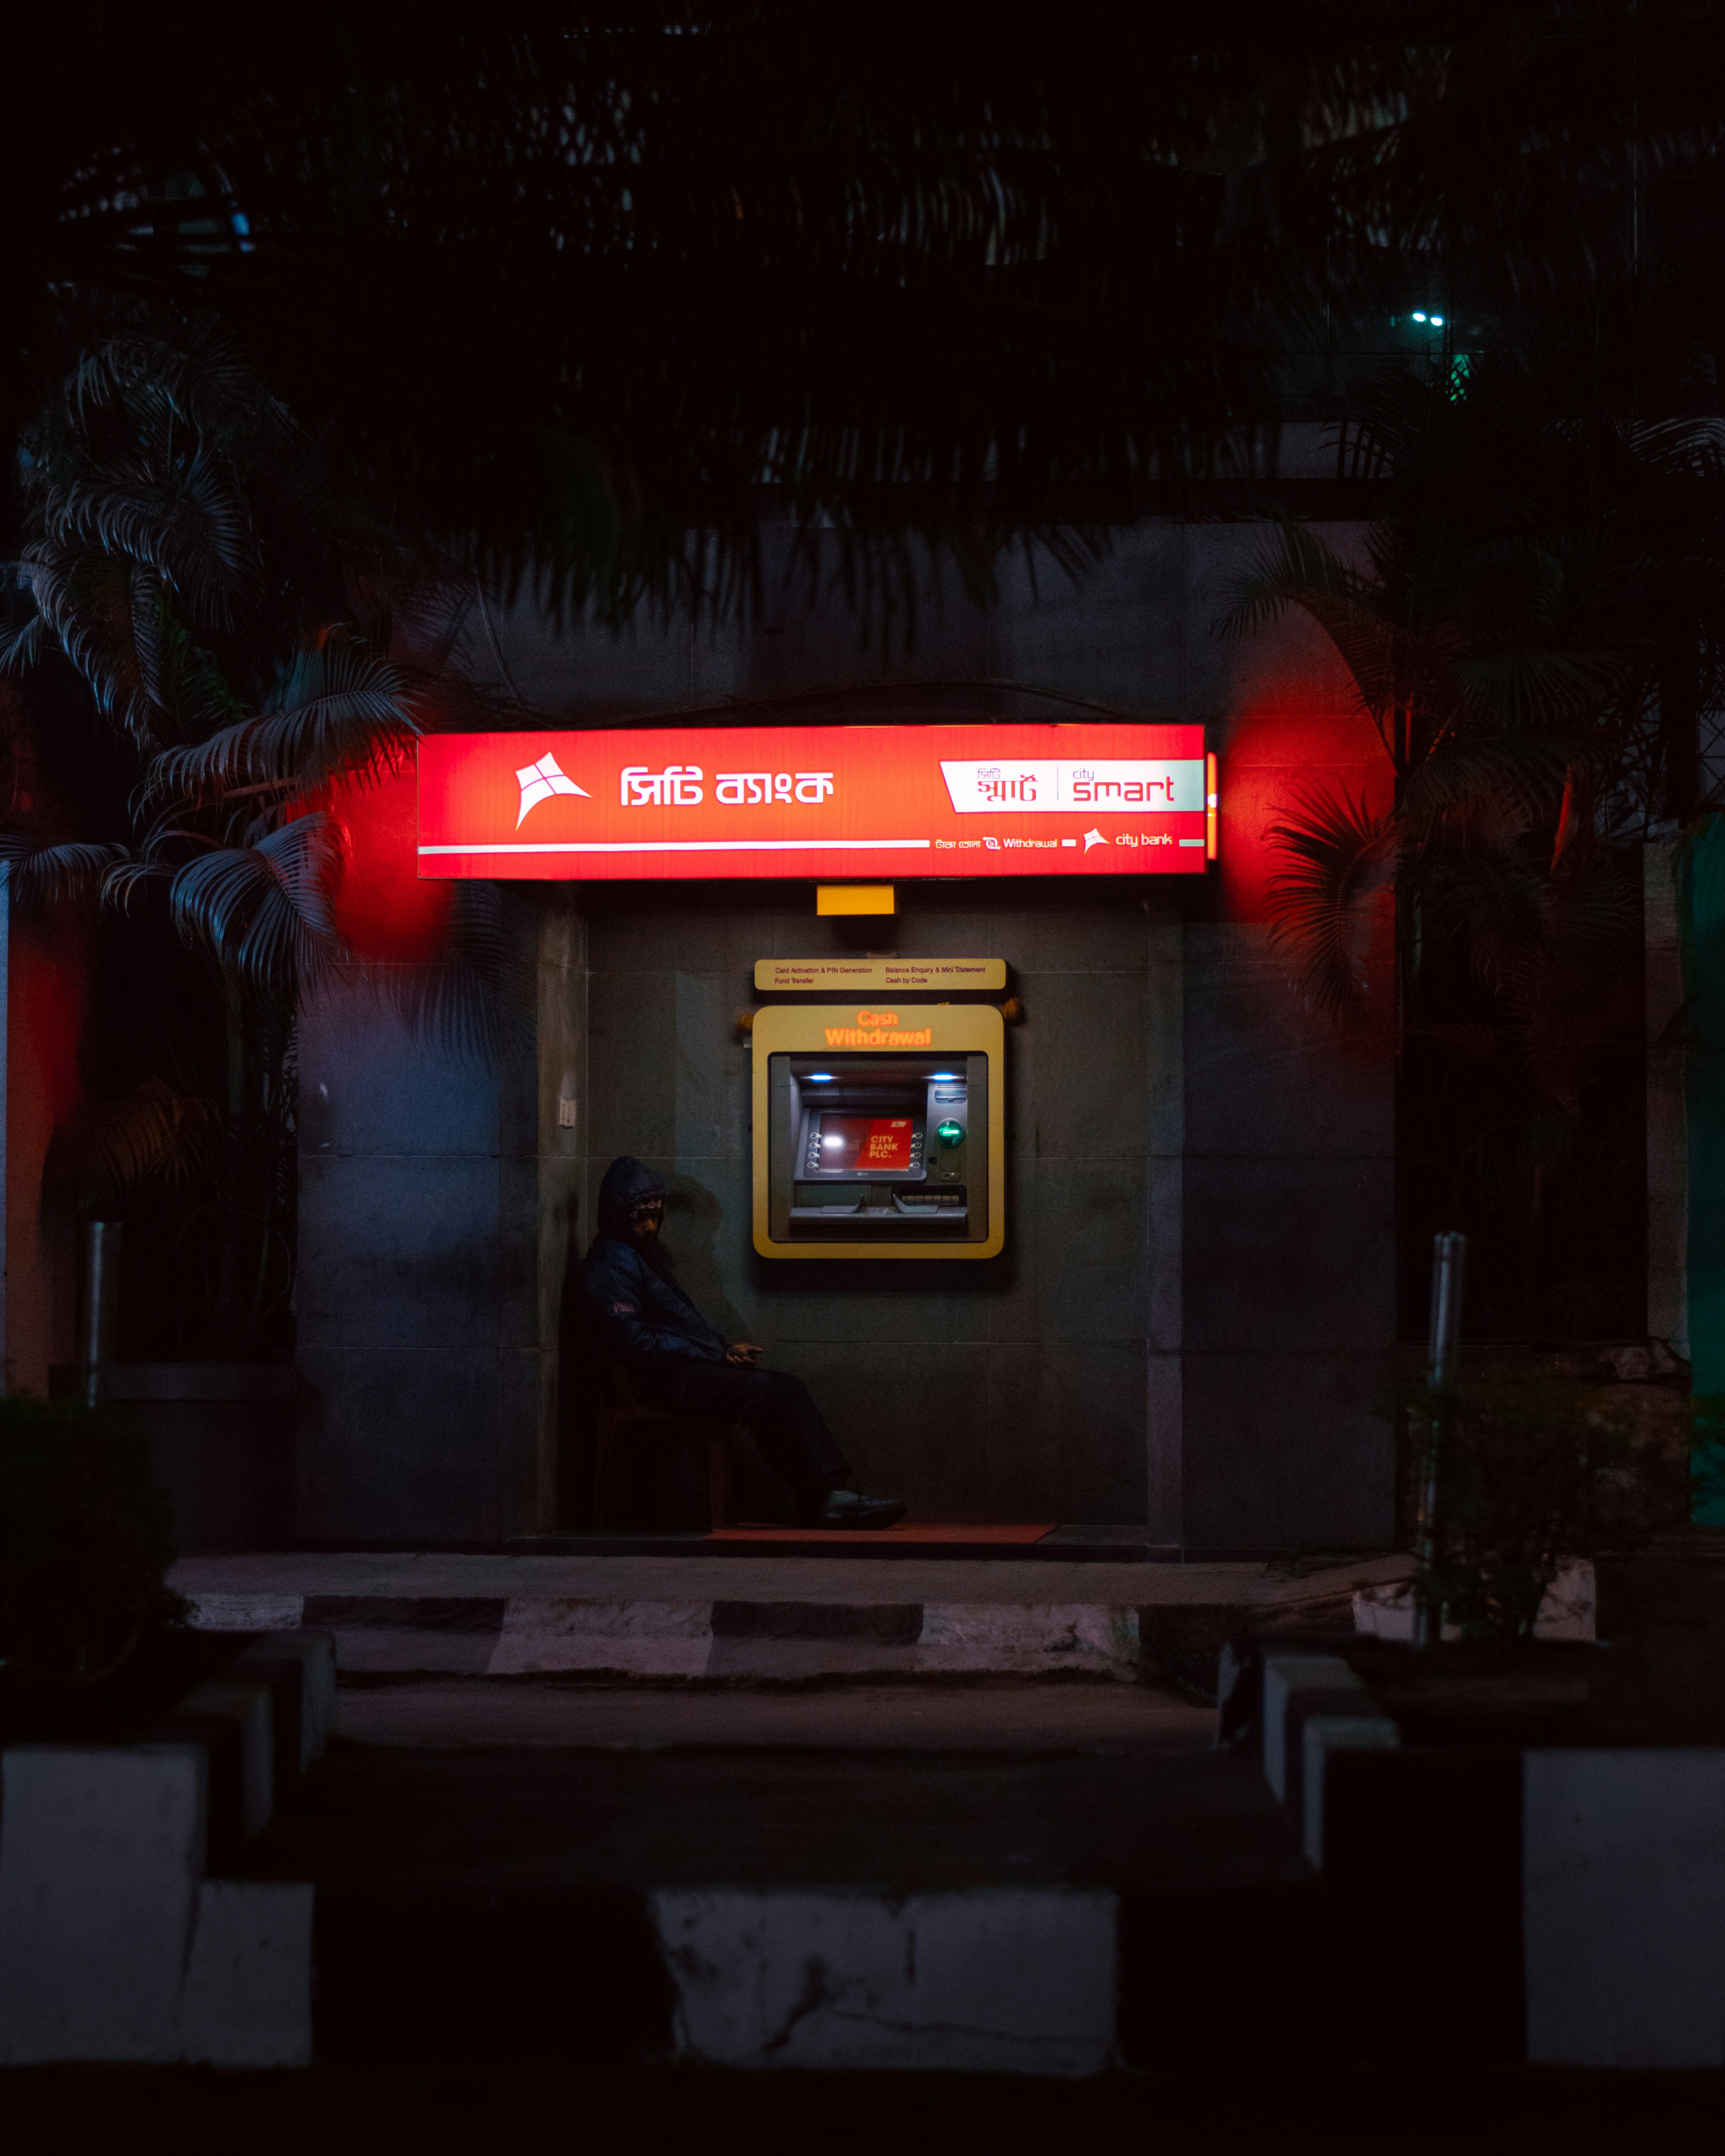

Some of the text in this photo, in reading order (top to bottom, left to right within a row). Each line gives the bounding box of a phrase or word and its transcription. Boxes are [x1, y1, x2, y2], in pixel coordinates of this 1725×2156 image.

[977, 768, 1001, 779] সিটি
[1073, 768, 1094, 781] city
[621, 766, 833, 805] সিটি ব্যাংক
[977, 774, 1039, 801] স্মার্ট
[1073, 776, 1174, 801] smart
[935, 839, 956, 848] টাকা
[1003, 838, 1057, 848] Withdrawal
[1116, 833, 1172, 847] city bank
[857, 1011, 899, 1026] Cash
[825, 1028, 931, 1046] Withdrawal
